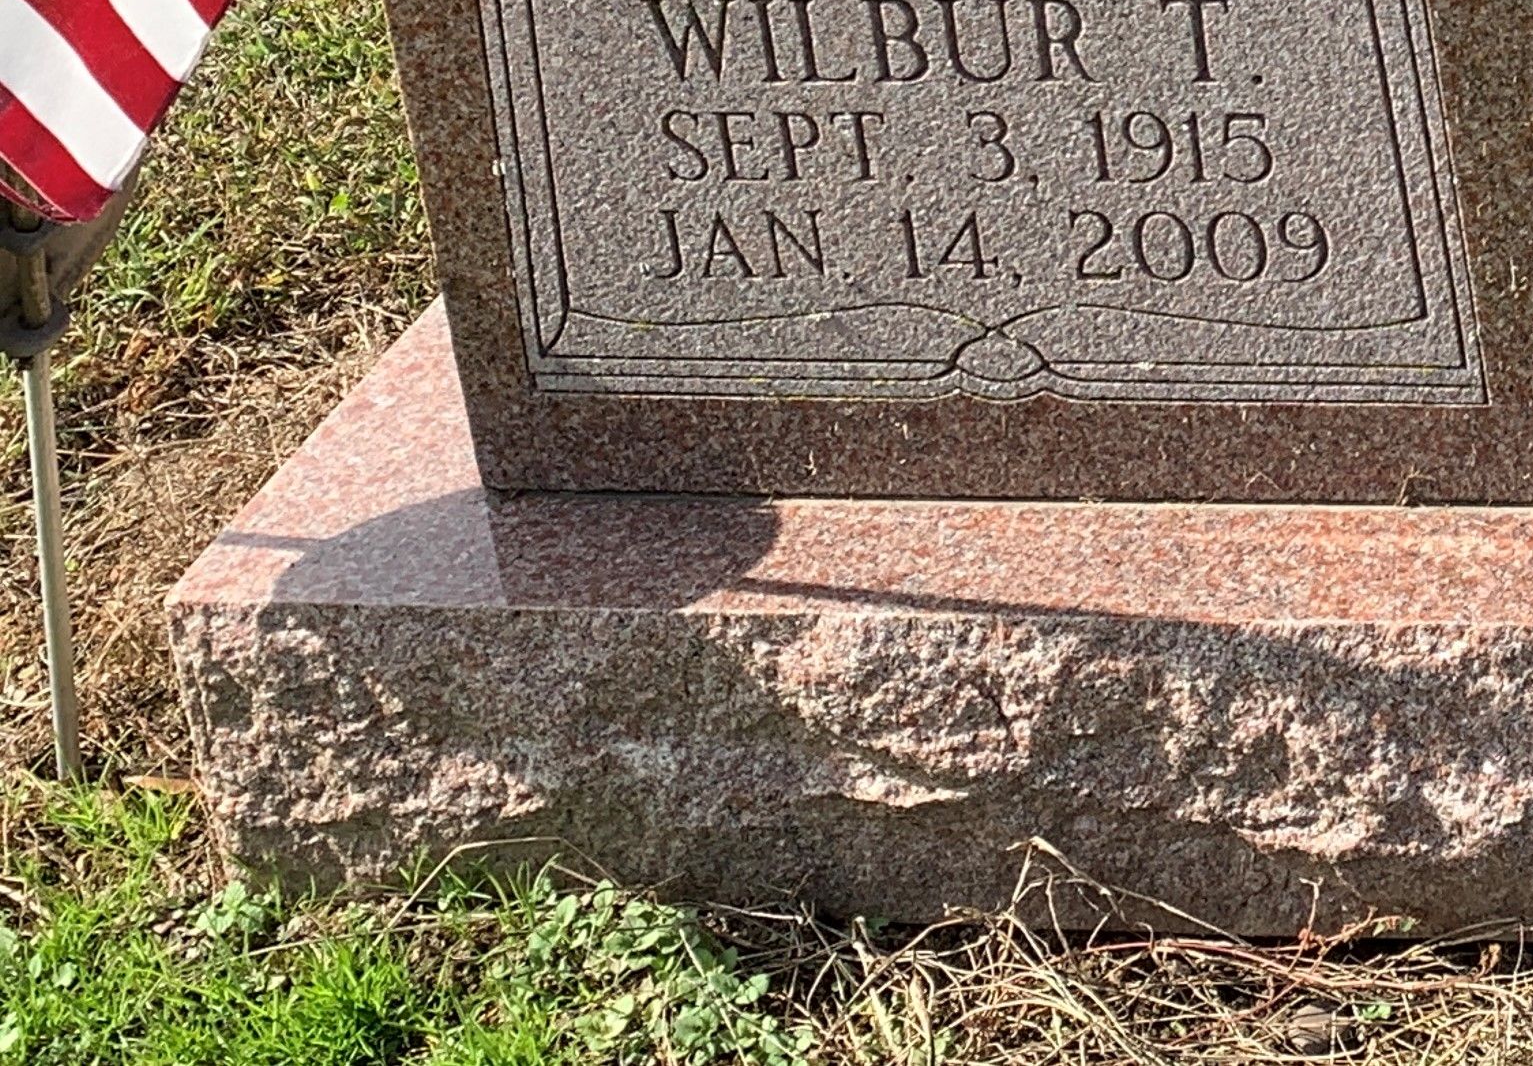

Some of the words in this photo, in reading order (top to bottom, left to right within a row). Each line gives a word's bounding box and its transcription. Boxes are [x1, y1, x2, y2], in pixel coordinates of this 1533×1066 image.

[660, 109, 918, 186] SEPT.
[970, 109, 1040, 193] 3,
[1085, 111, 1274, 183] 1915
[646, 209, 853, 283] JAN.
[900, 209, 1023, 288] 14,
[1069, 209, 1331, 283] 2009
